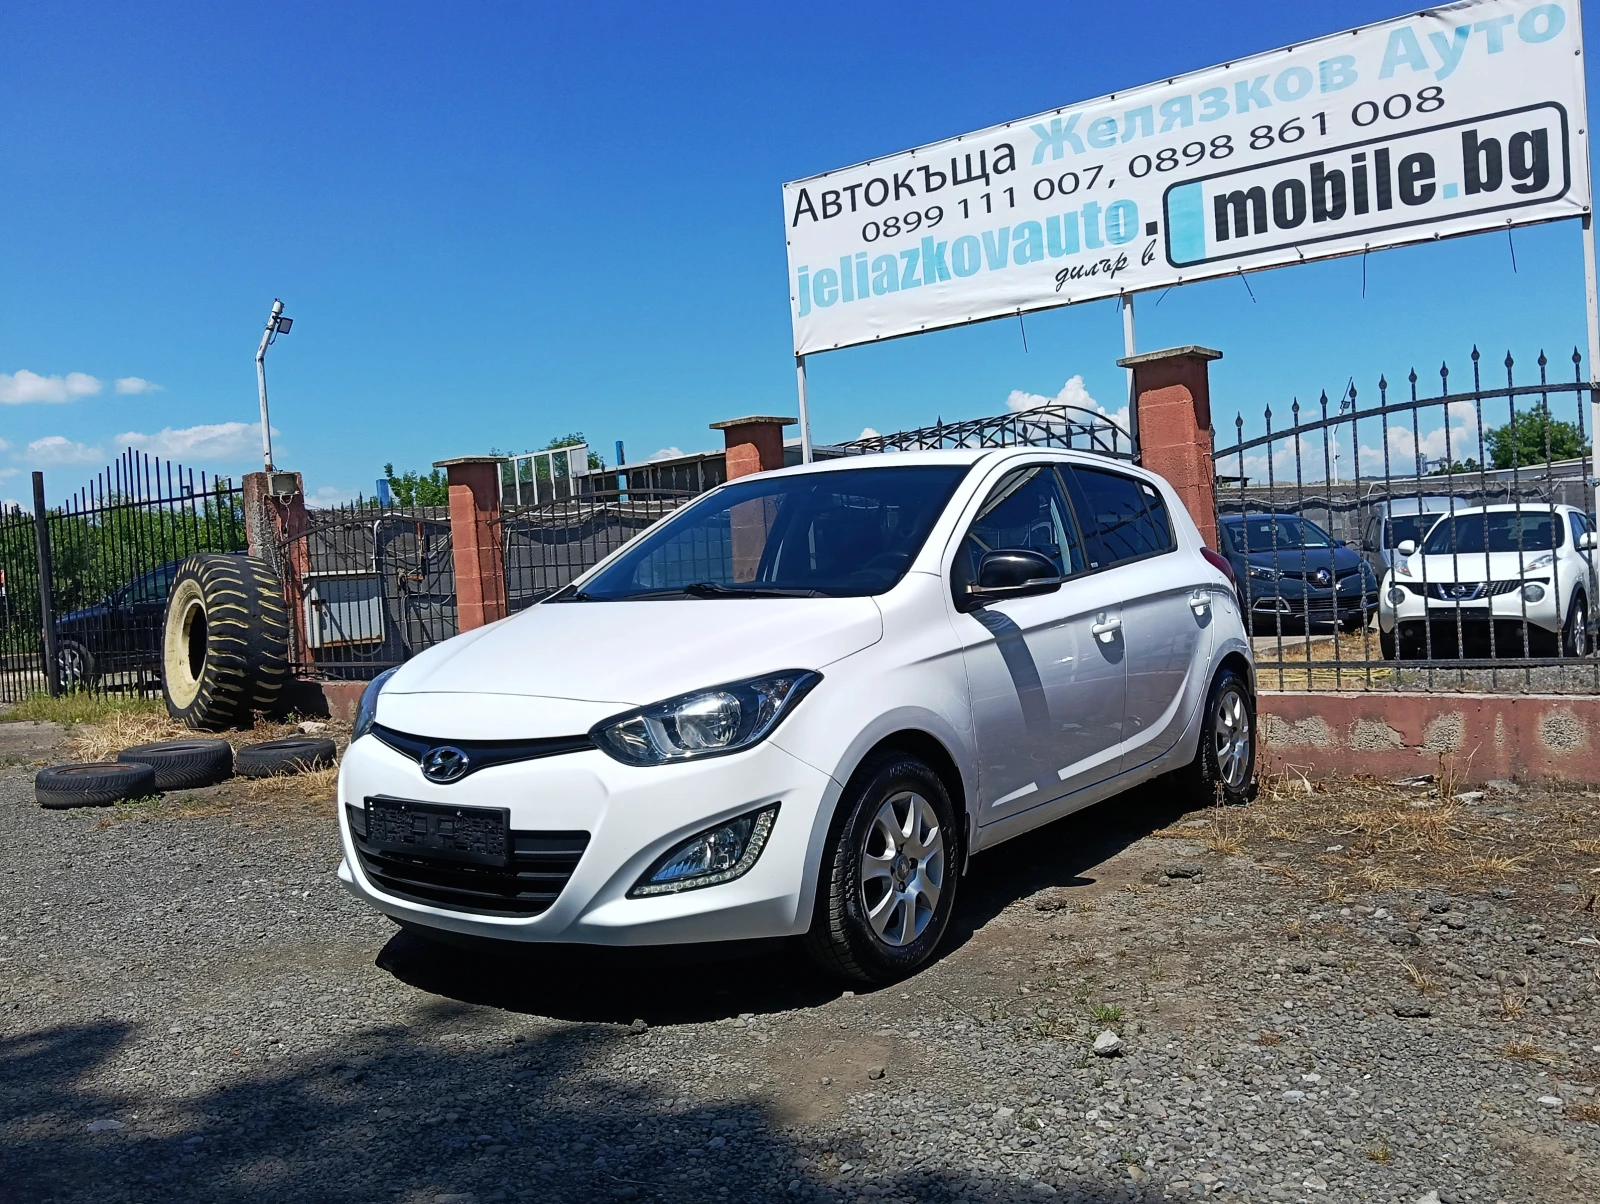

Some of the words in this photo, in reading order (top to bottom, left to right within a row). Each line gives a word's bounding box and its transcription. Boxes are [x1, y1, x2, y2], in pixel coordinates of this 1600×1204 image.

[792, 142, 1016, 228] Автокъща
[1031, 55, 1358, 166] Желязков
[1378, 3, 1567, 81] Ауто
[861, 205, 945, 243] 0899
[956, 187, 1017, 220] 111
[1032, 164, 1116, 201] 007,
[1127, 135, 1235, 178] 0898
[1249, 111, 1328, 151] 861
[1351, 86, 1446, 127] 008
[1214, 127, 1550, 242] mobile.bg
[1054, 252, 1130, 291] дилър
[1140, 238, 1157, 267] в
